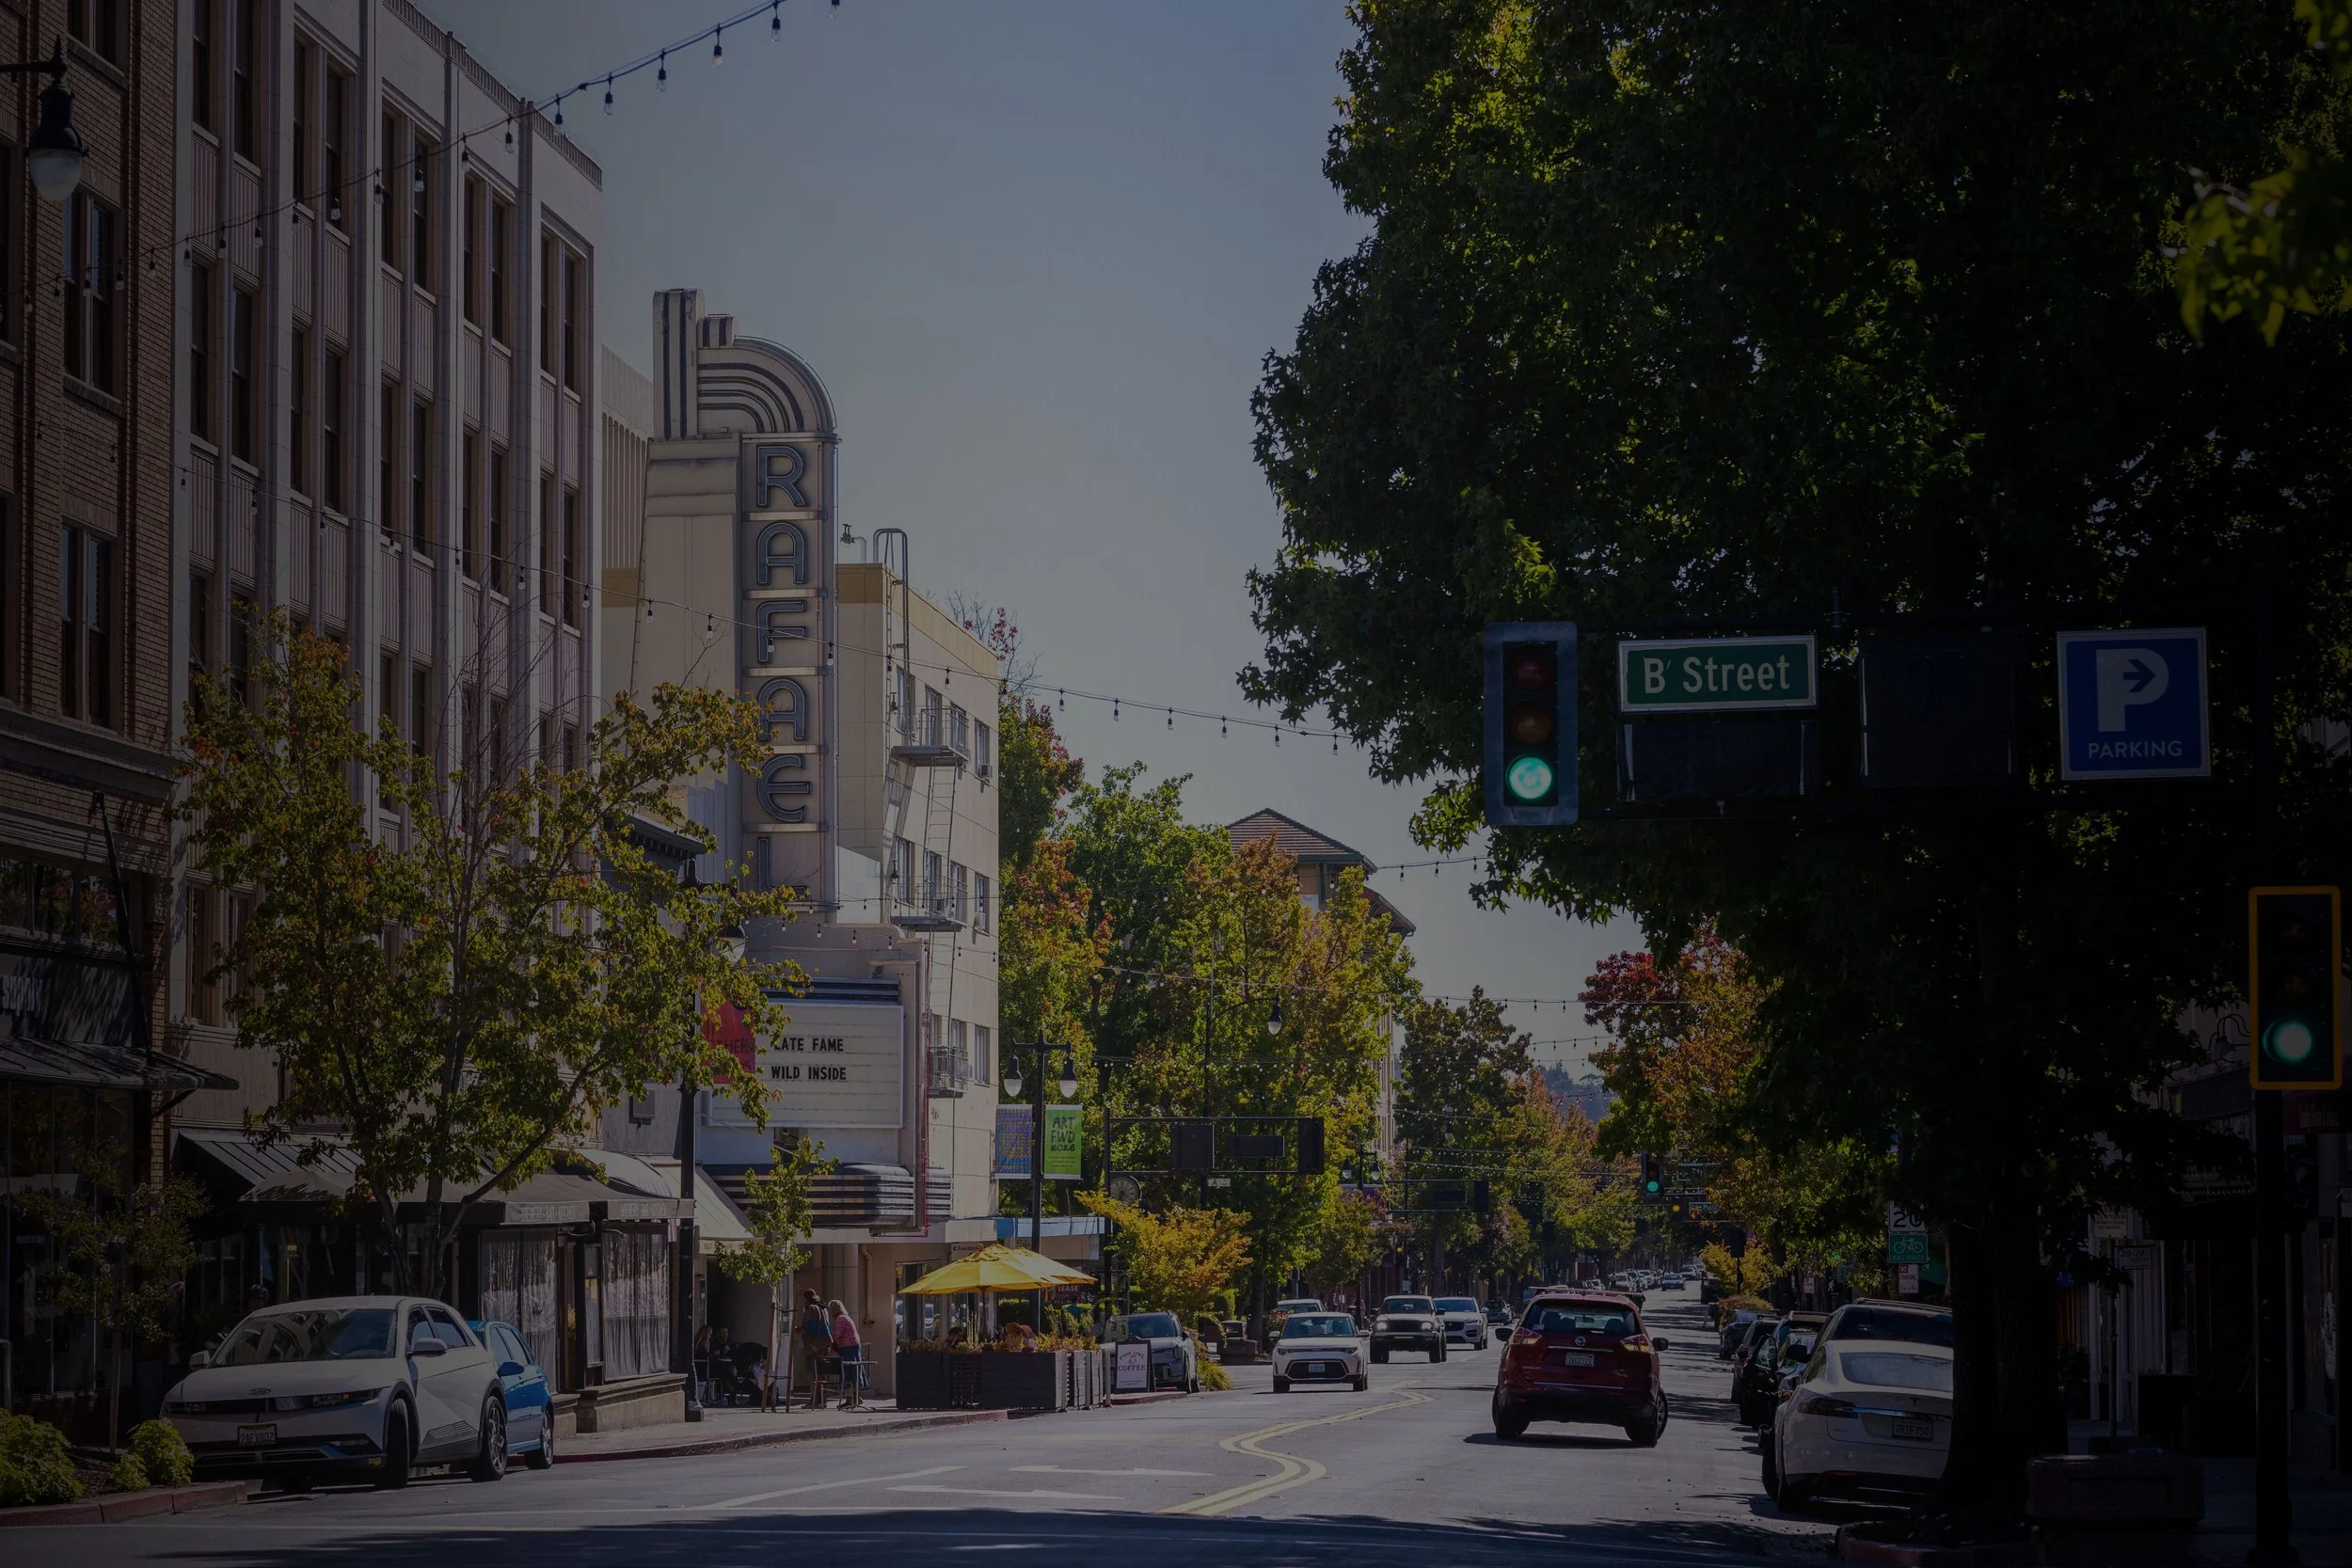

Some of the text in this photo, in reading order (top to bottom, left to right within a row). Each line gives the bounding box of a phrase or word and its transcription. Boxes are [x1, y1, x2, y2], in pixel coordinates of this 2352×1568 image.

[755, 443, 812, 898] RAFAEL
[1683, 655, 1790, 693] Street
[2096, 648, 2169, 732] P
[2088, 740, 2183, 758] PARKING
[774, 1037, 843, 1052] LATE FAME
[771, 1066, 847, 1080] WILD INSIDE
[1052, 1117, 1074, 1130] ART
[1051, 1130, 1075, 1143] FWD
[2121, 1249, 2145, 1258] 20/20
